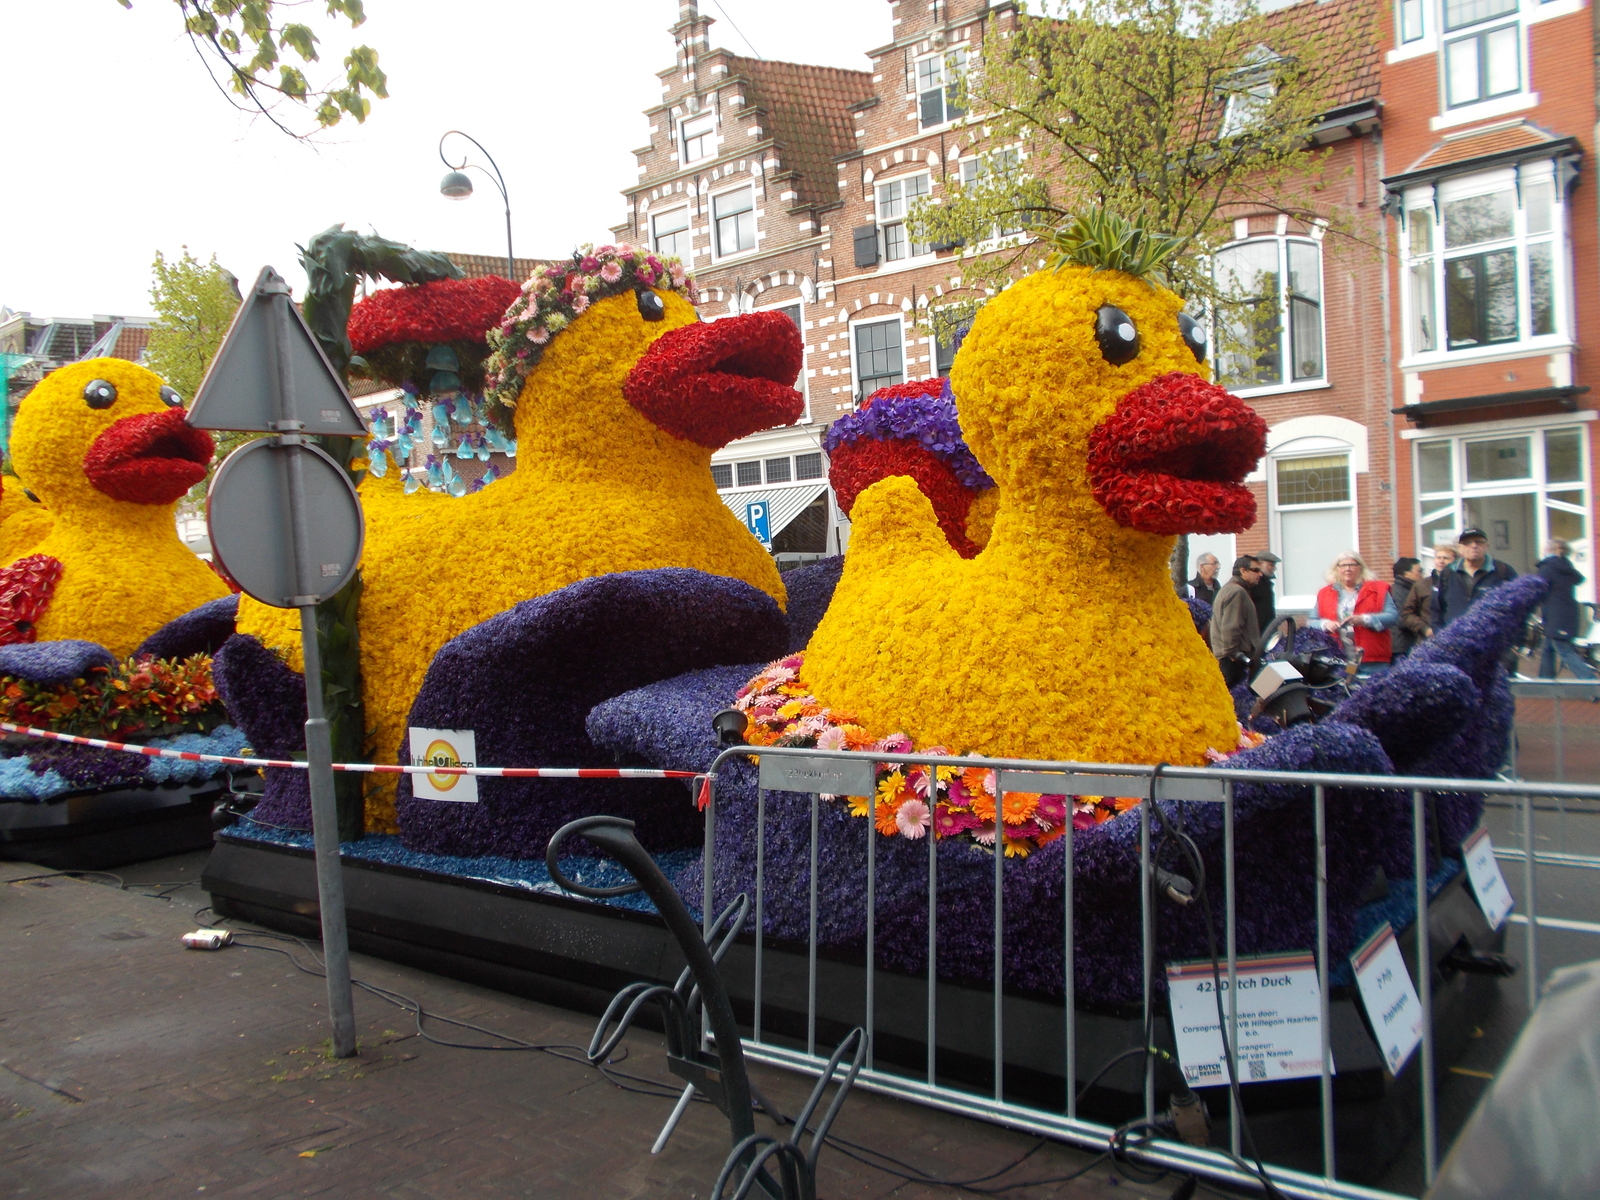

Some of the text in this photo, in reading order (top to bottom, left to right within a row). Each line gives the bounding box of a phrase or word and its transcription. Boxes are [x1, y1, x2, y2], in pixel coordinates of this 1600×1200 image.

[751, 504, 763, 528] P
[1196, 975, 1292, 993] 42. Dtch Duck
[1182, 1024, 1222, 1035] Corsogroe
[1251, 1018, 1285, 1028] Hillegom
[1286, 1014, 1319, 1024] Haarlem
[1238, 1043, 1274, 1052] rrangeur:
[1250, 1052, 1265, 1060] van
[1266, 1049, 1294, 1058] Namen
[1198, 1063, 1221, 1071] DUTCH
[1199, 1069, 1222, 1077] DESIGN
